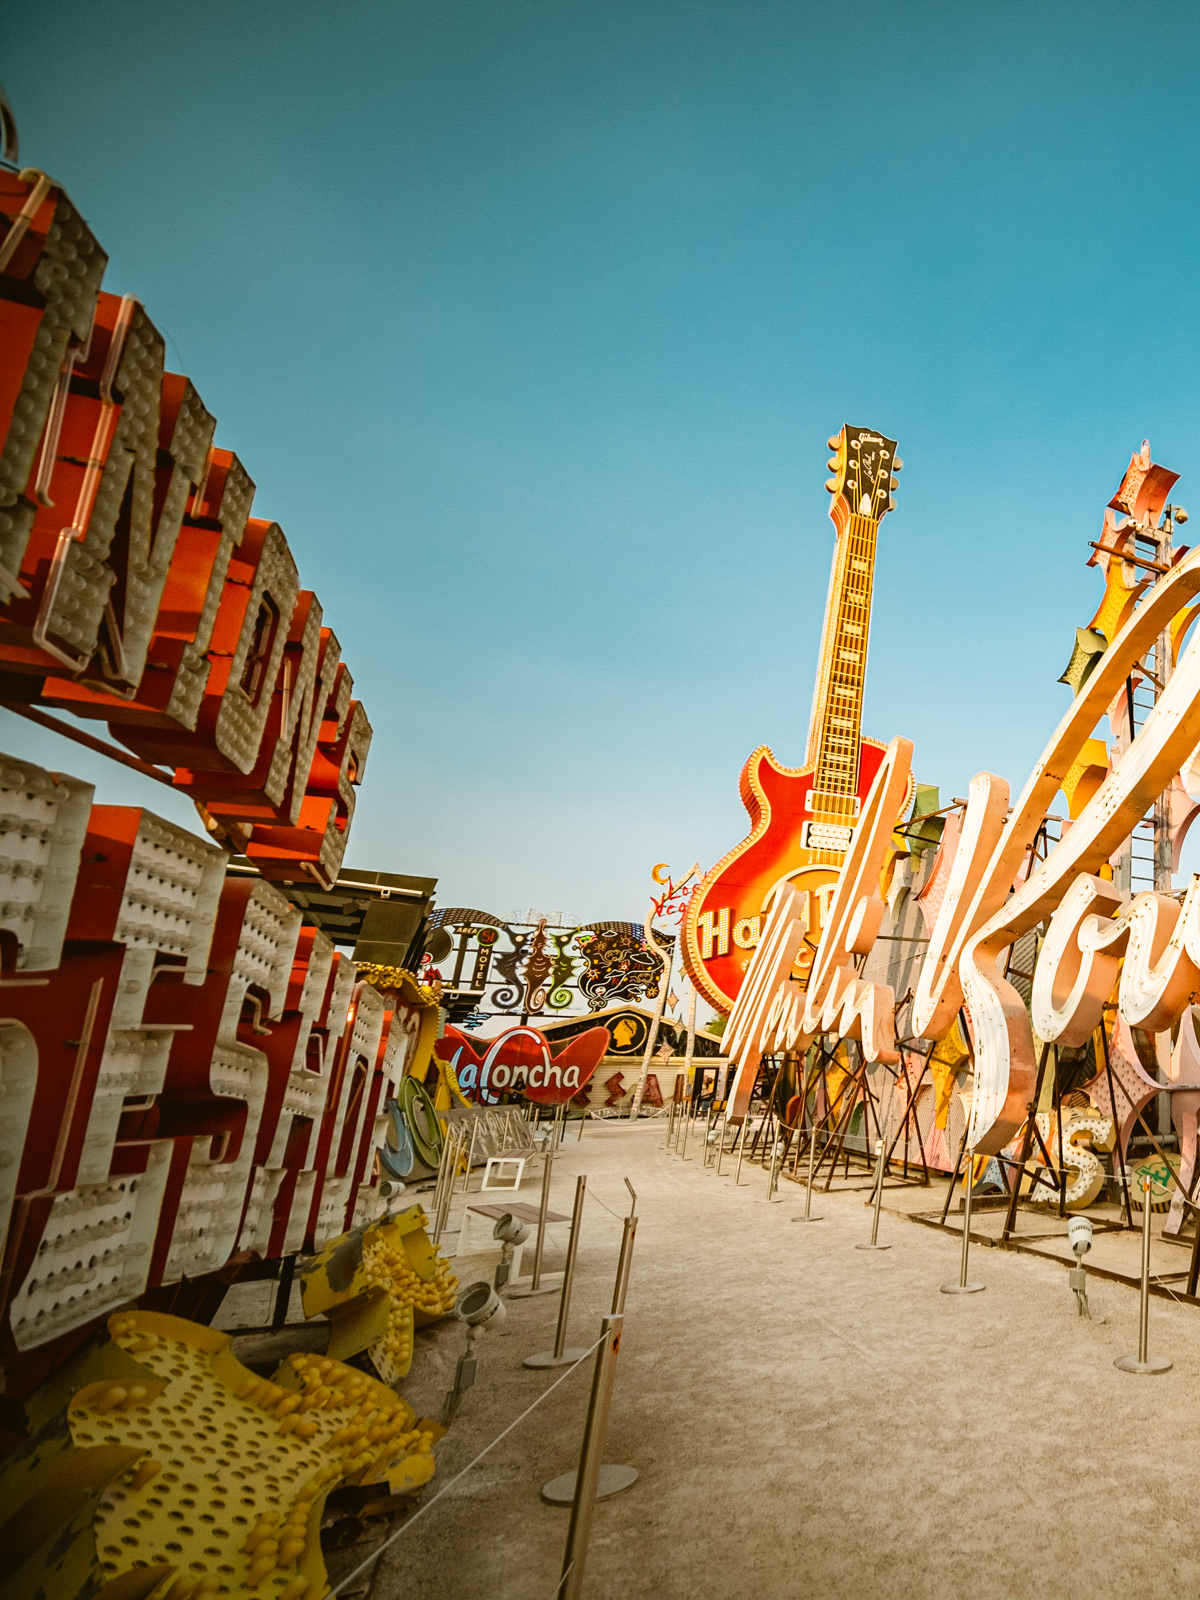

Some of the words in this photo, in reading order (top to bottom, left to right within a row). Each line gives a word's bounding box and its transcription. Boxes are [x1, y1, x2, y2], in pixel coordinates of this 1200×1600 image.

[859, 433, 884, 446] Gibson
[456, 926, 478, 935] AREA
[480, 930, 495, 943] 51
[474, 947, 490, 988] MOTEL
[480, 1028, 580, 1105] Concha
